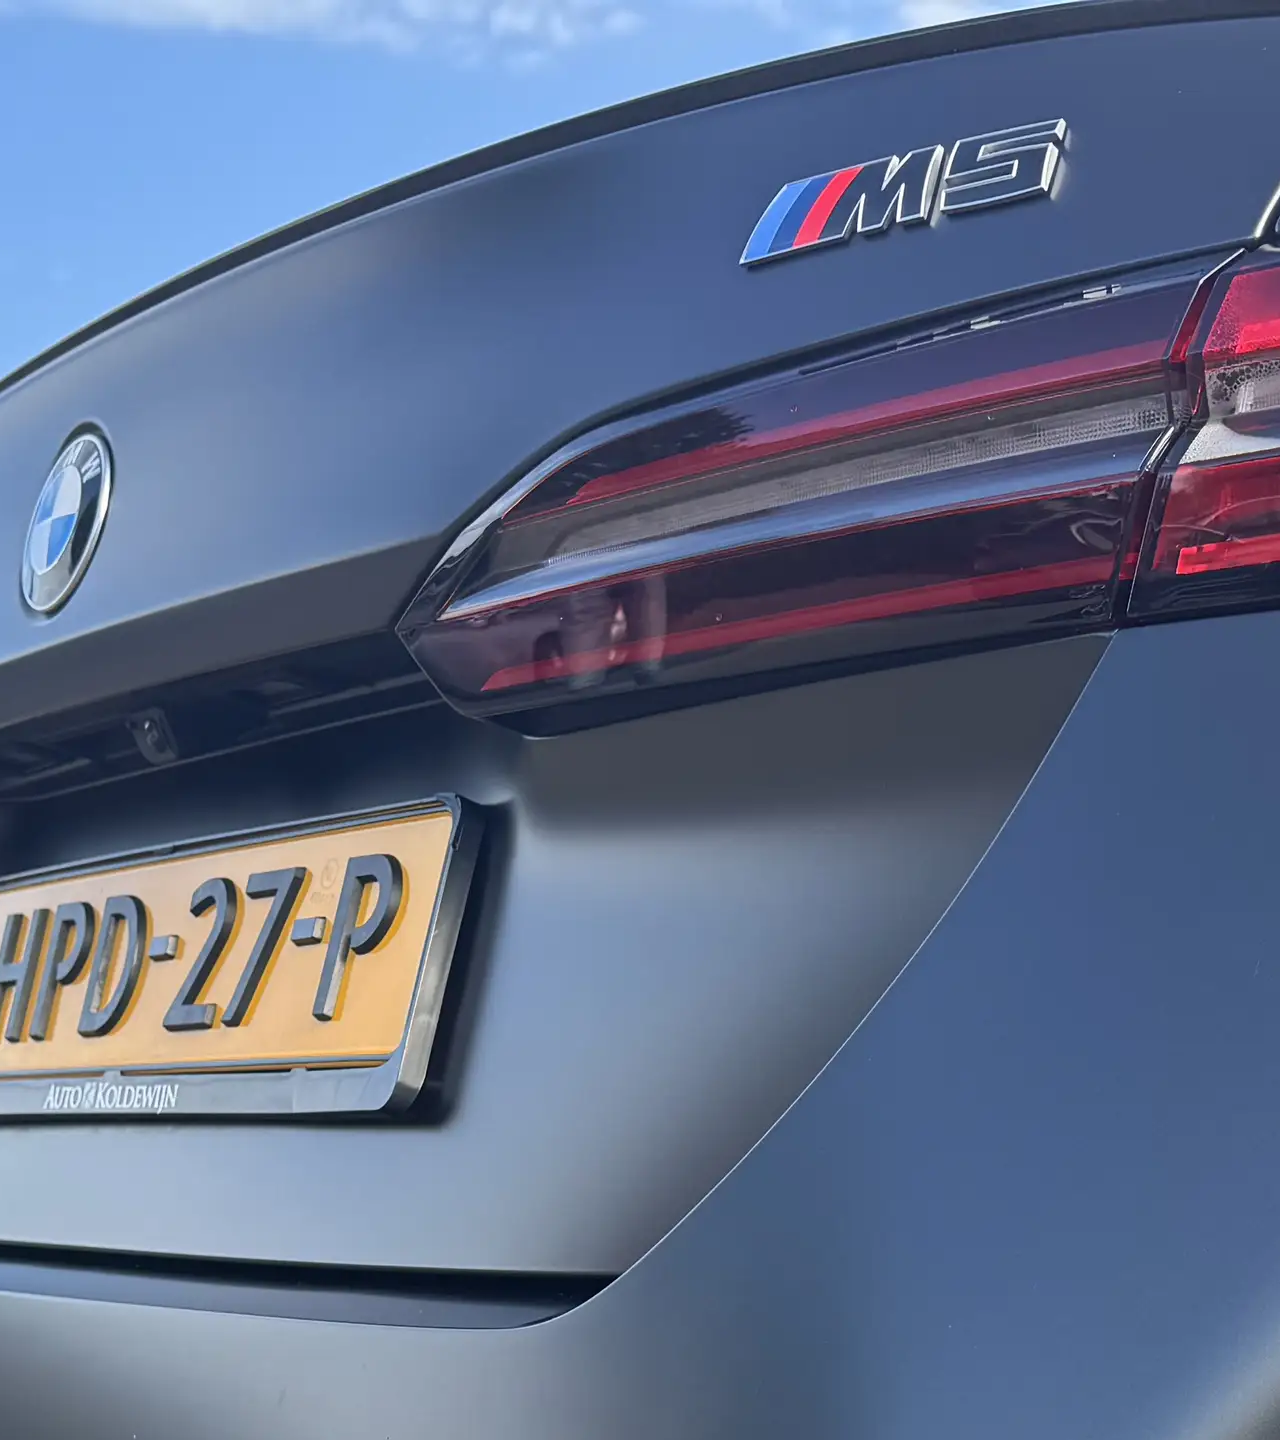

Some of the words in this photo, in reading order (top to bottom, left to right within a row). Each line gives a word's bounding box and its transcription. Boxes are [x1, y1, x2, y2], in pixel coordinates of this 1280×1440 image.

[815, 118, 1066, 242] M5
[43, 1083, 82, 1110] AUTO
[95, 1082, 179, 1115] KOLDEWIJN
